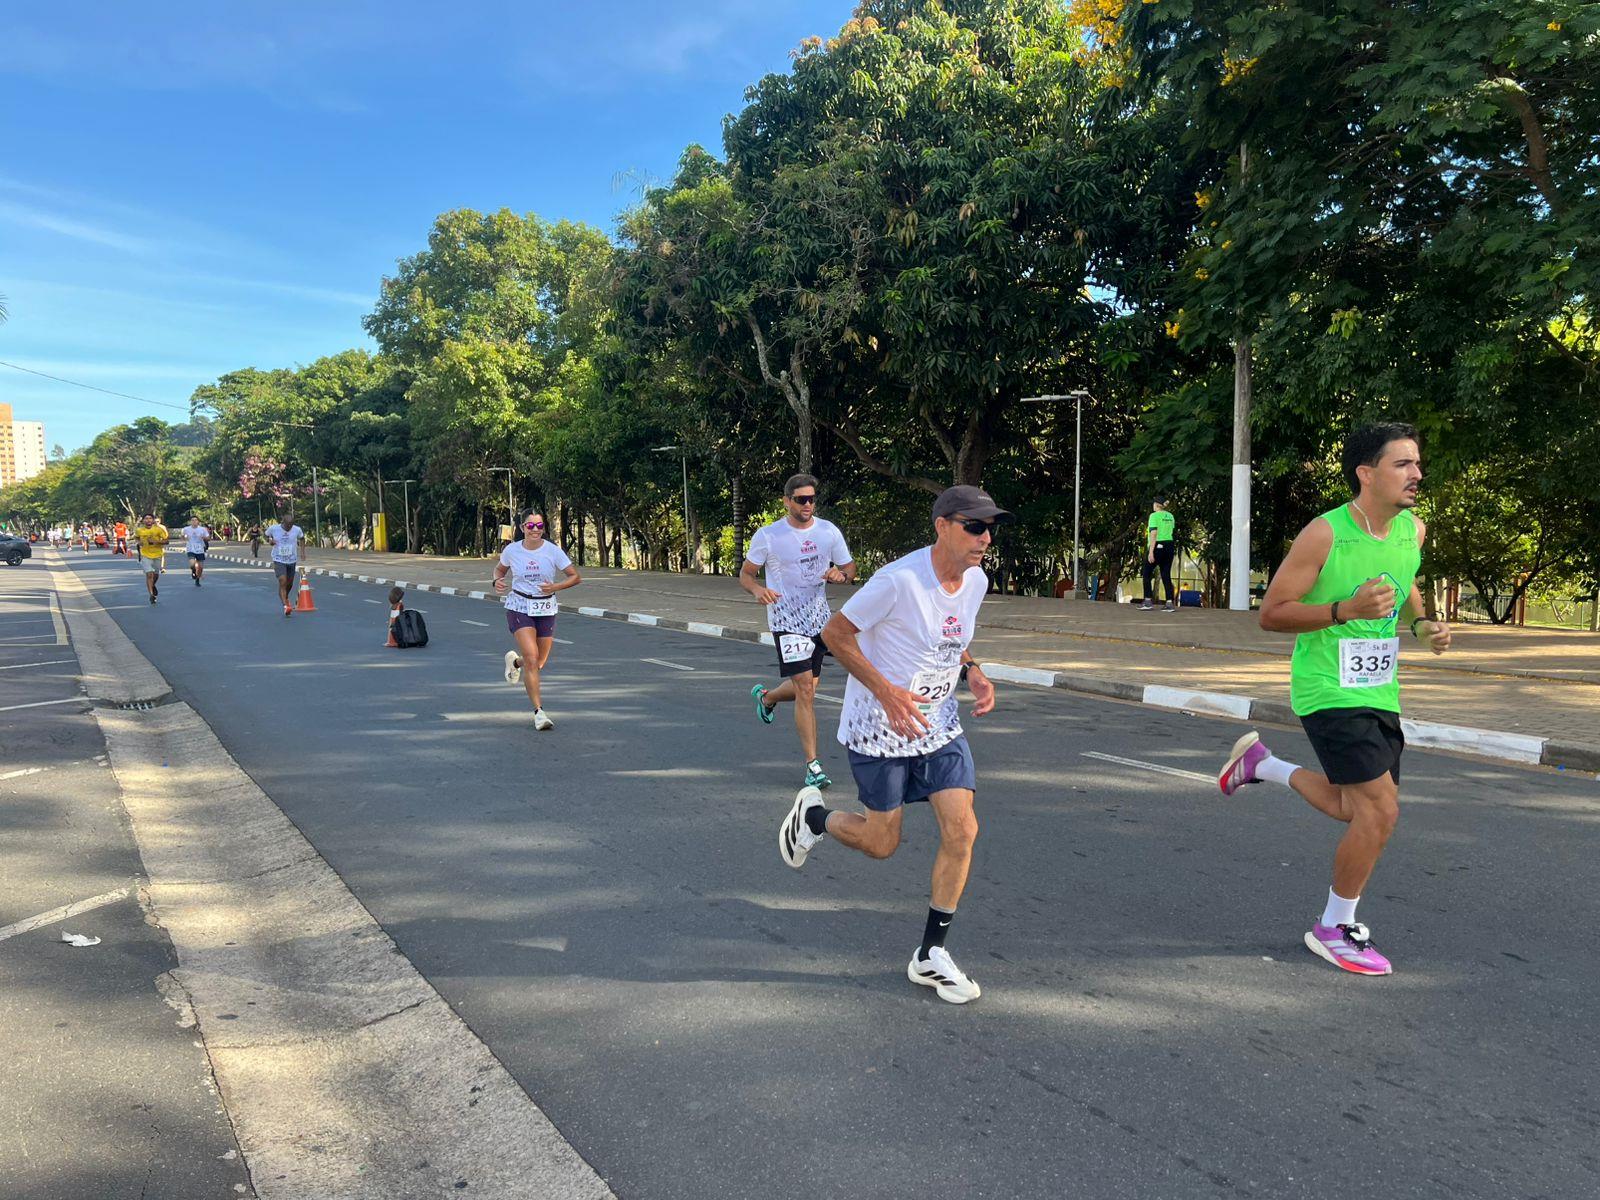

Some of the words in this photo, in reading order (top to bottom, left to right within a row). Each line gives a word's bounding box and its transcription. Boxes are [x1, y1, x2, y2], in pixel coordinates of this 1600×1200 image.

[532, 601, 551, 610] 376
[783, 642, 810, 654] 217
[1350, 654, 1391, 672] 335
[918, 682, 951, 700] 229
